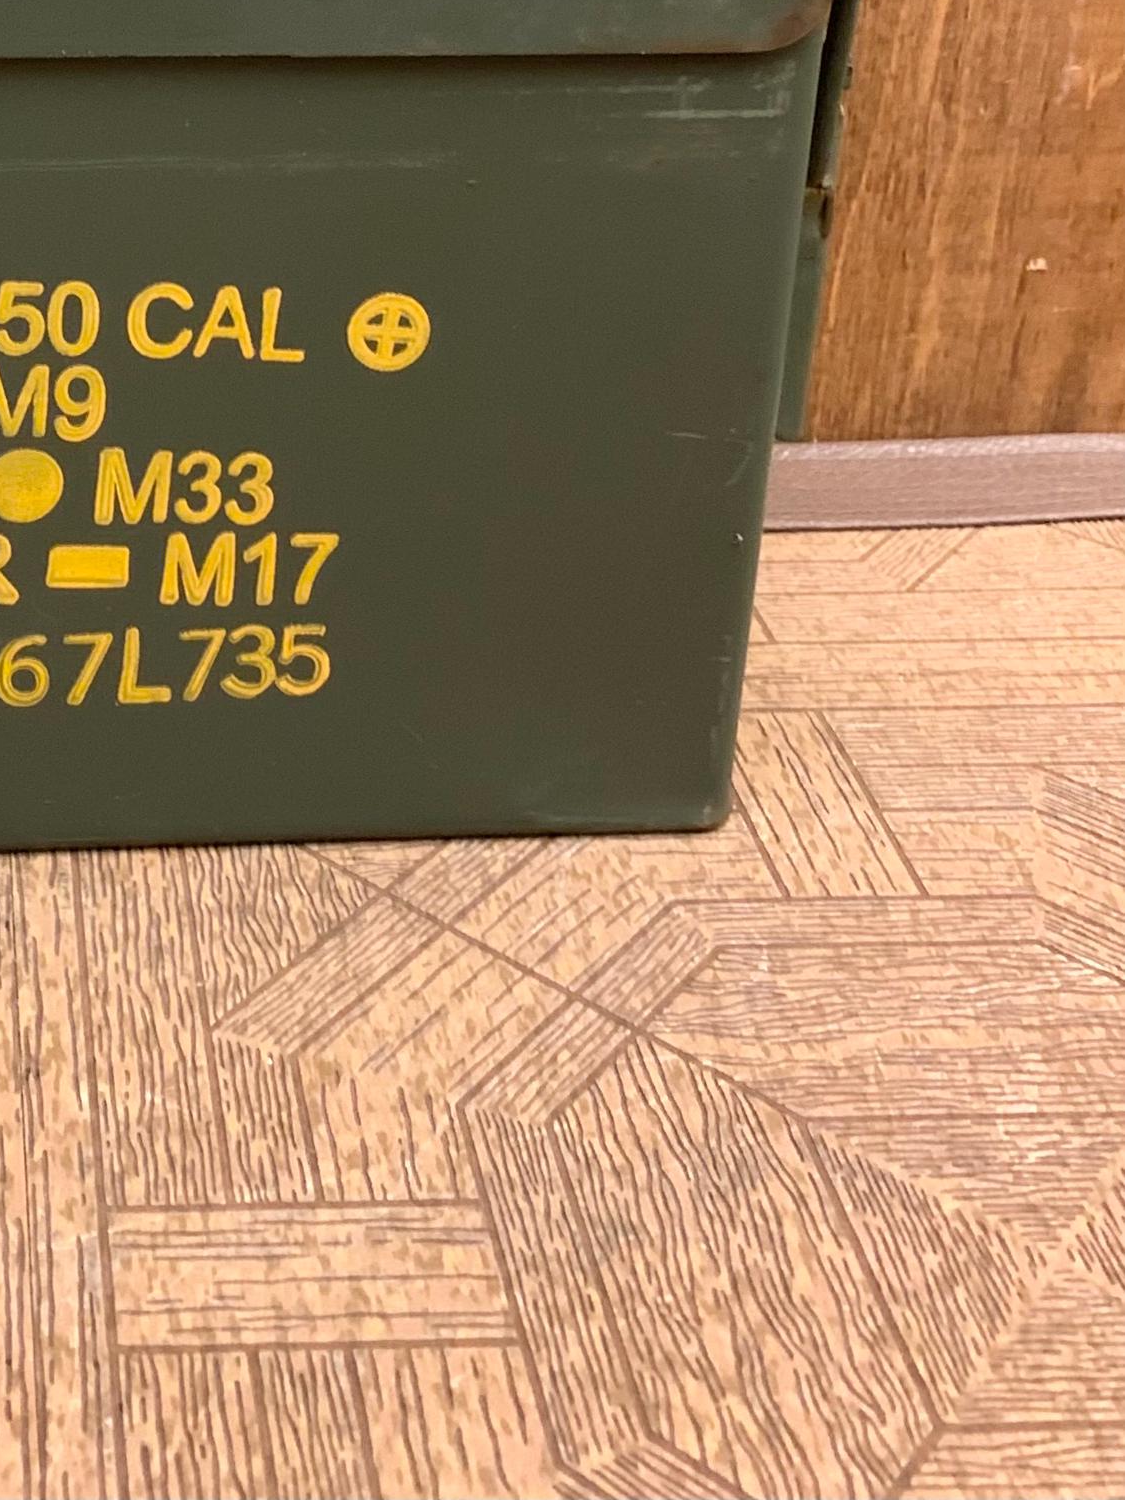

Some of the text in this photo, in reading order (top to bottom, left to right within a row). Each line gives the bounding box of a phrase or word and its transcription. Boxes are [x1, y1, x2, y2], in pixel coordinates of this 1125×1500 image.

[126, 281, 306, 363] CAL
[93, 445, 275, 527] M33
[160, 530, 340, 608] M17
